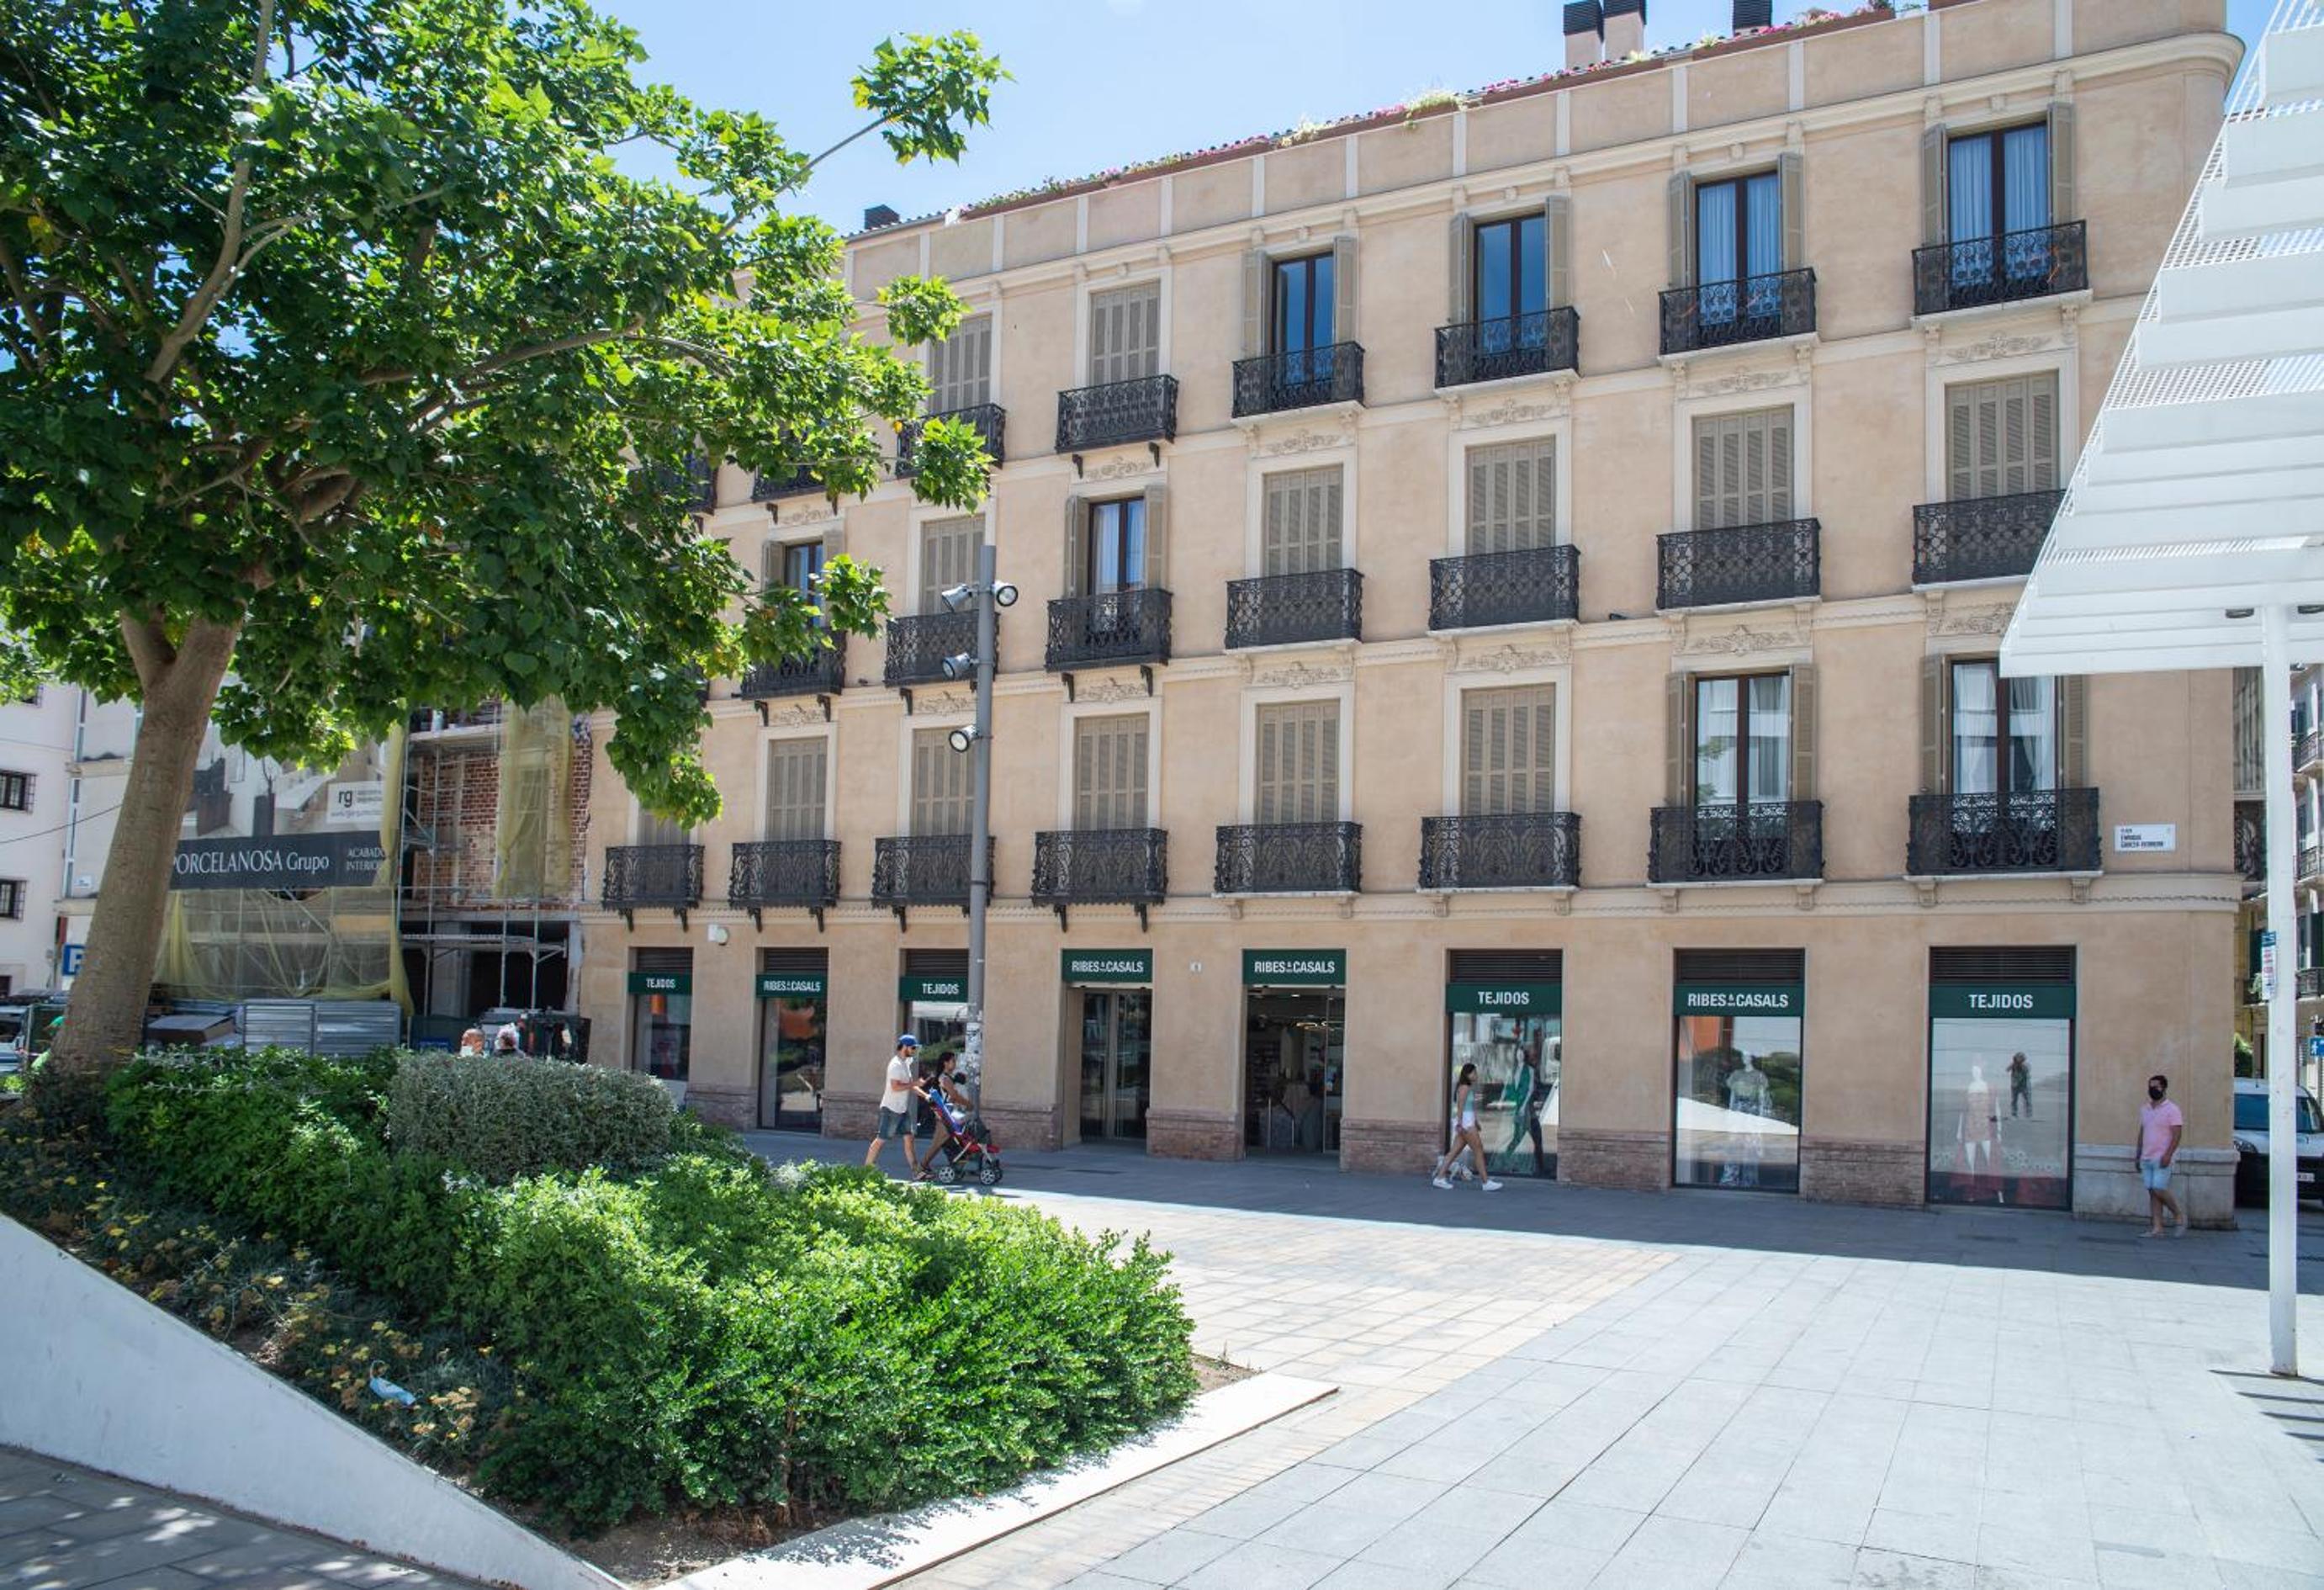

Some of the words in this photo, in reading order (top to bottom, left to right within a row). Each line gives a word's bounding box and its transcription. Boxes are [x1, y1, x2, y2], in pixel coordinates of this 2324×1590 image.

[338, 790, 352, 808] rg
[286, 852, 329, 875] Grupo
[1071, 961, 1099, 973] RIBES
[1106, 961, 1144, 973] CASALS
[1254, 961, 1285, 973] RIBES
[1293, 961, 1336, 973] CASALS
[646, 978, 675, 988] TEJIDOS
[764, 980, 786, 991] RIBES
[791, 980, 821, 992] CASALS
[922, 983, 959, 994] TEJIDOS
[1478, 991, 1530, 1004] TEJIDOS
[1687, 994, 1727, 1006] RIBES
[1736, 994, 1789, 1008] CASALS
[1968, 994, 2034, 1008] TEJIDOS
